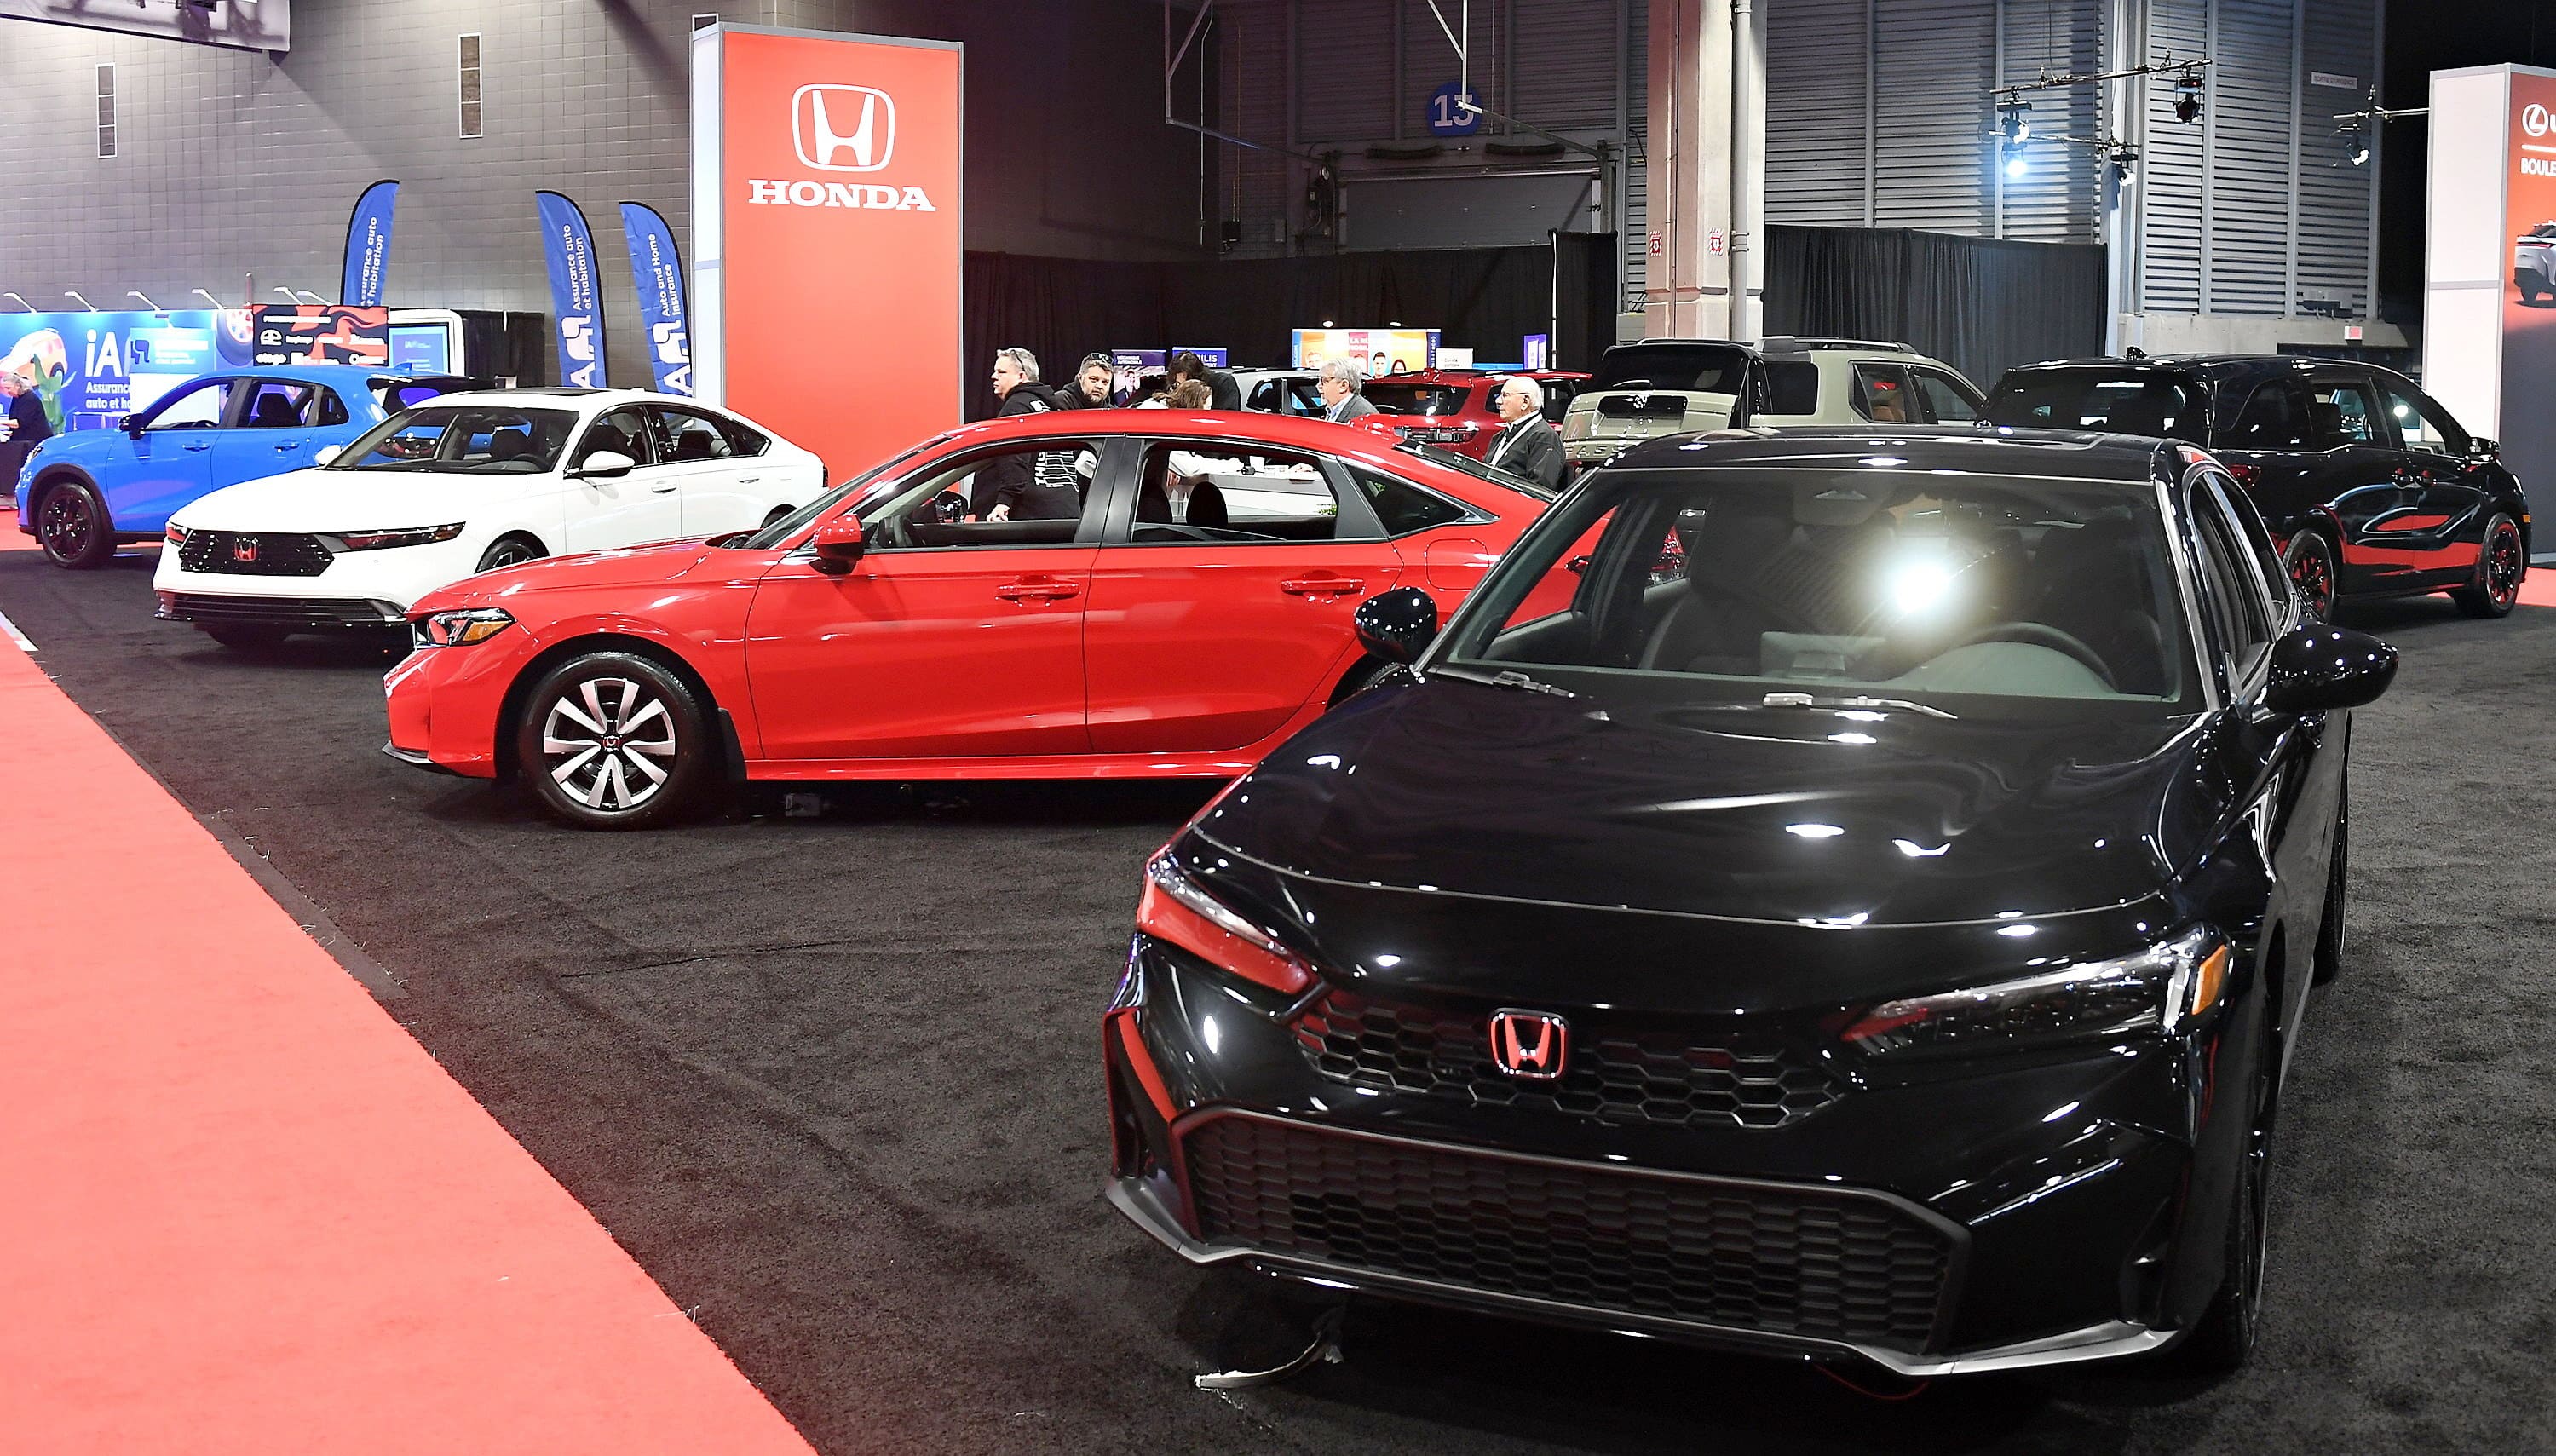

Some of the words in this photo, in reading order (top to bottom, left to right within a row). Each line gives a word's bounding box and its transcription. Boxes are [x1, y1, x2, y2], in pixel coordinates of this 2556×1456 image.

[1434, 94, 1474, 127] 13
[748, 179, 936, 212] HONDA
[367, 216, 377, 245] auto
[563, 224, 573, 252] auto
[367, 234, 383, 297] habitation
[648, 233, 661, 267] Home
[567, 253, 582, 311] Assurance
[575, 237, 591, 296] habitation
[653, 268, 665, 290] and
[584, 297, 592, 310] et
[657, 291, 671, 317] Auto
[86, 397, 108, 409] auto
[109, 397, 120, 409] et
